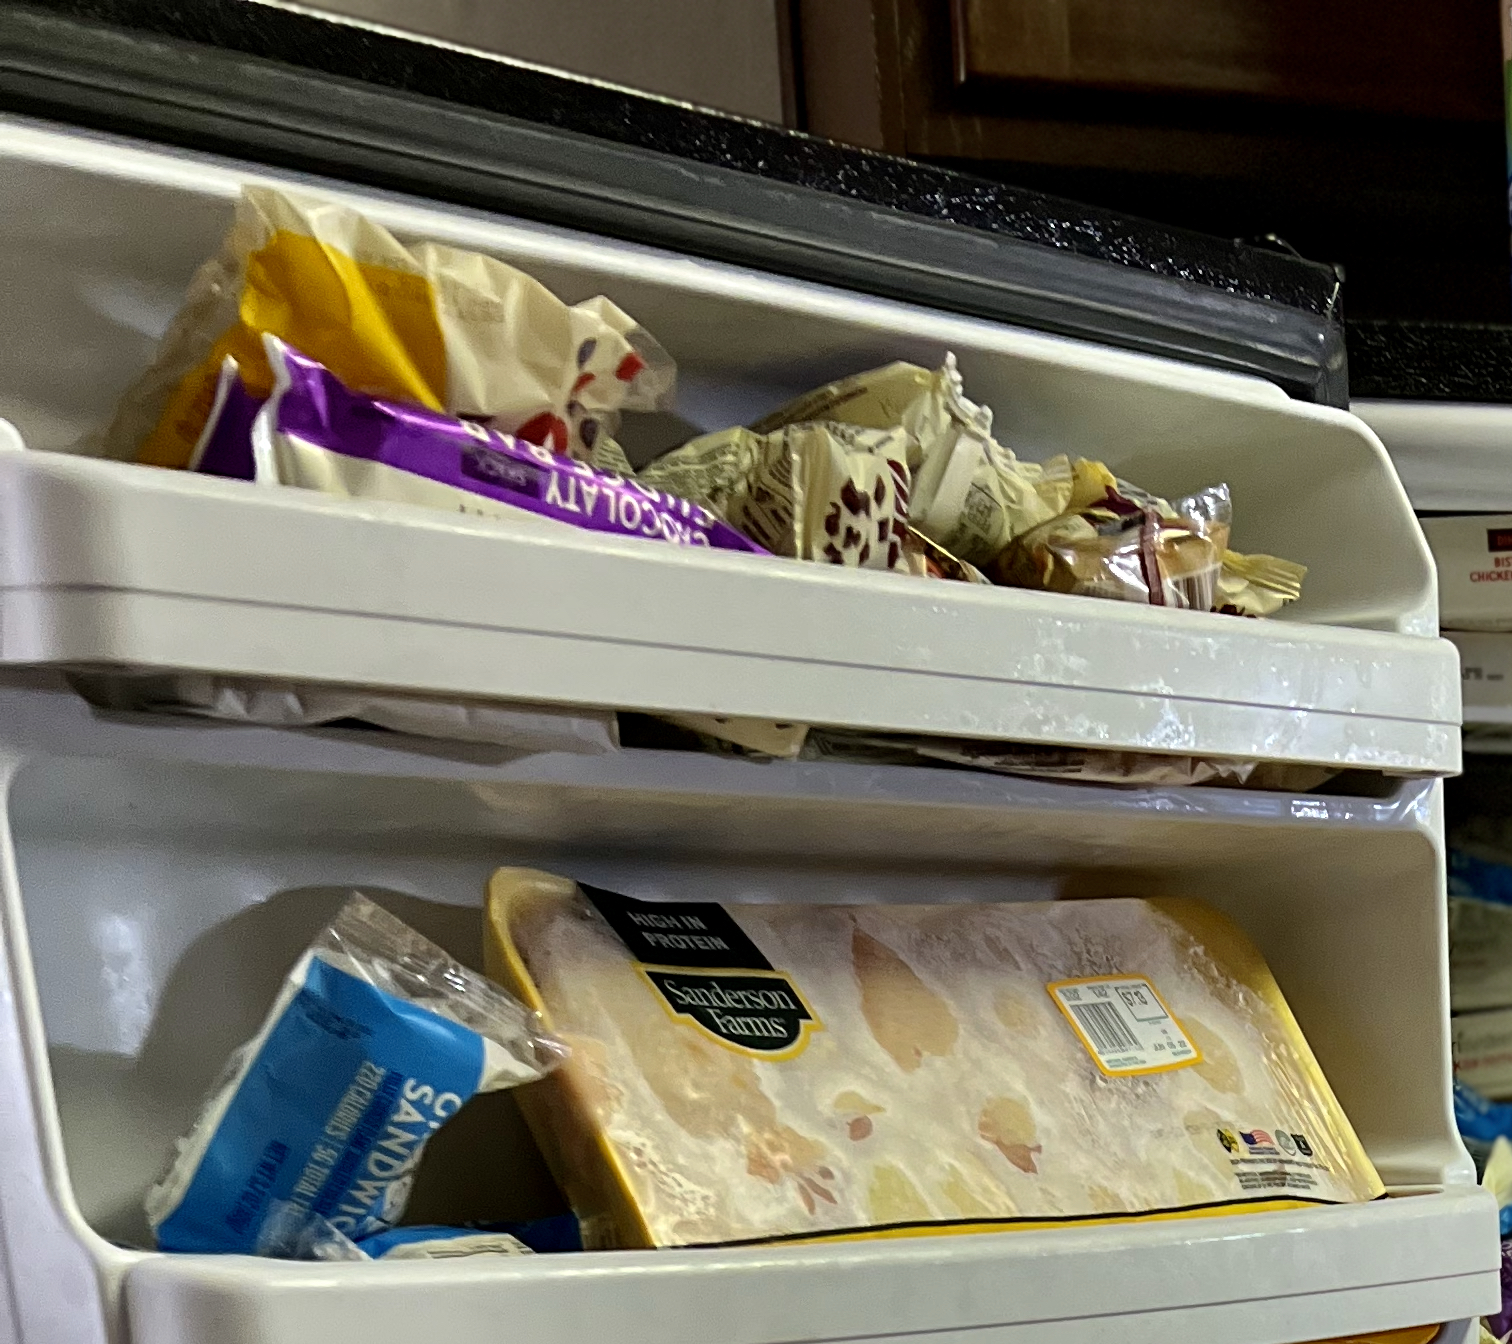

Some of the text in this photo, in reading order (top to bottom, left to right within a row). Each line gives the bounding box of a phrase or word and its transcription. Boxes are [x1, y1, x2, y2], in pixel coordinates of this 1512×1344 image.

[627, 910, 708, 931] HIGH IN
[641, 931, 730, 950] PROTEIN
[663, 979, 798, 1011] Sanderson
[704, 1008, 789, 1039] Farms
[328, 1077, 434, 1237] SANDWIC
